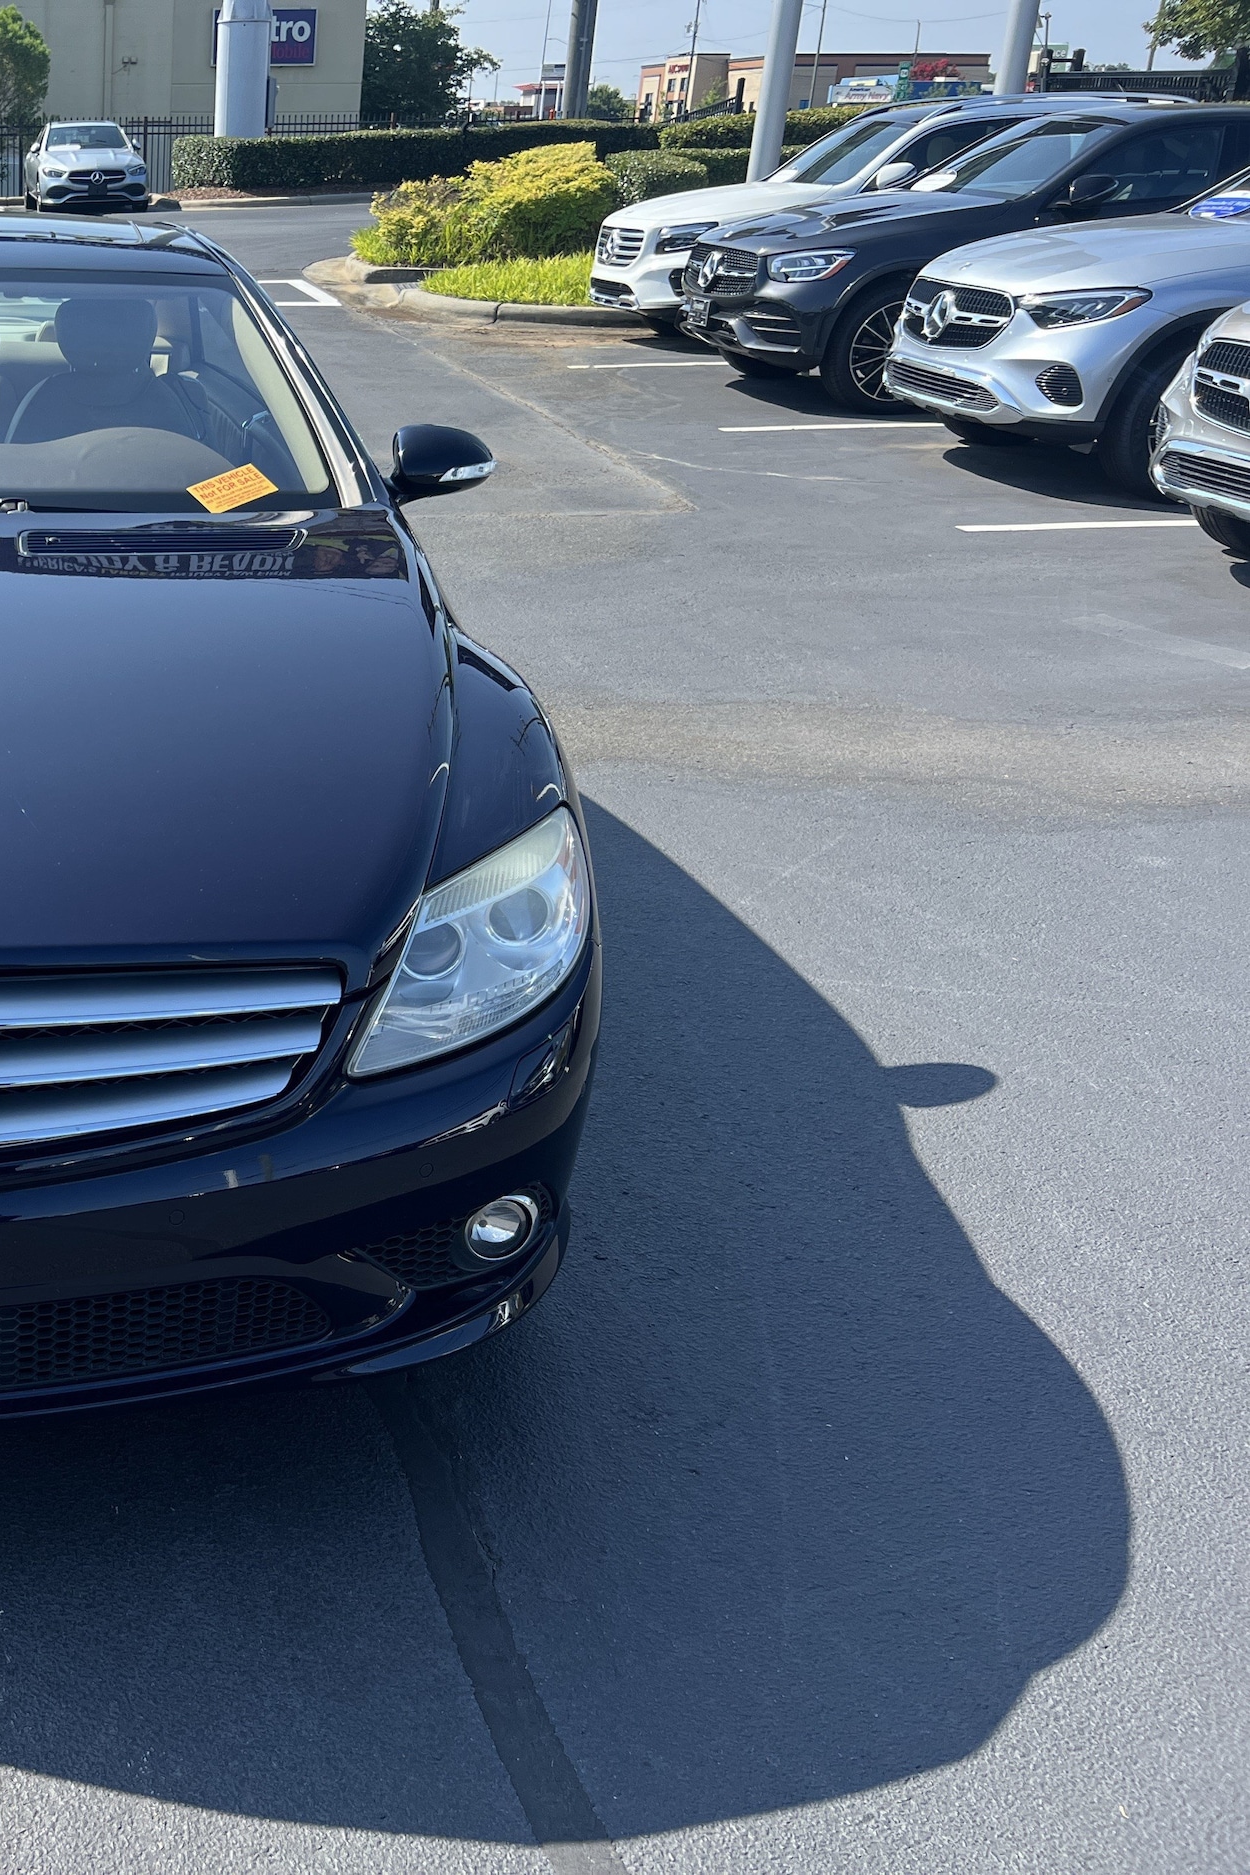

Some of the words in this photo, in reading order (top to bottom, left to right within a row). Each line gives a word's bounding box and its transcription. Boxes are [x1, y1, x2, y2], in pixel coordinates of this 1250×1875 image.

[271, 15, 312, 42] tro
[193, 482, 216, 493] THIS
[215, 466, 255, 485] VEHICLE
[217, 482, 237, 494] FOR
[237, 472, 263, 486] SALE
